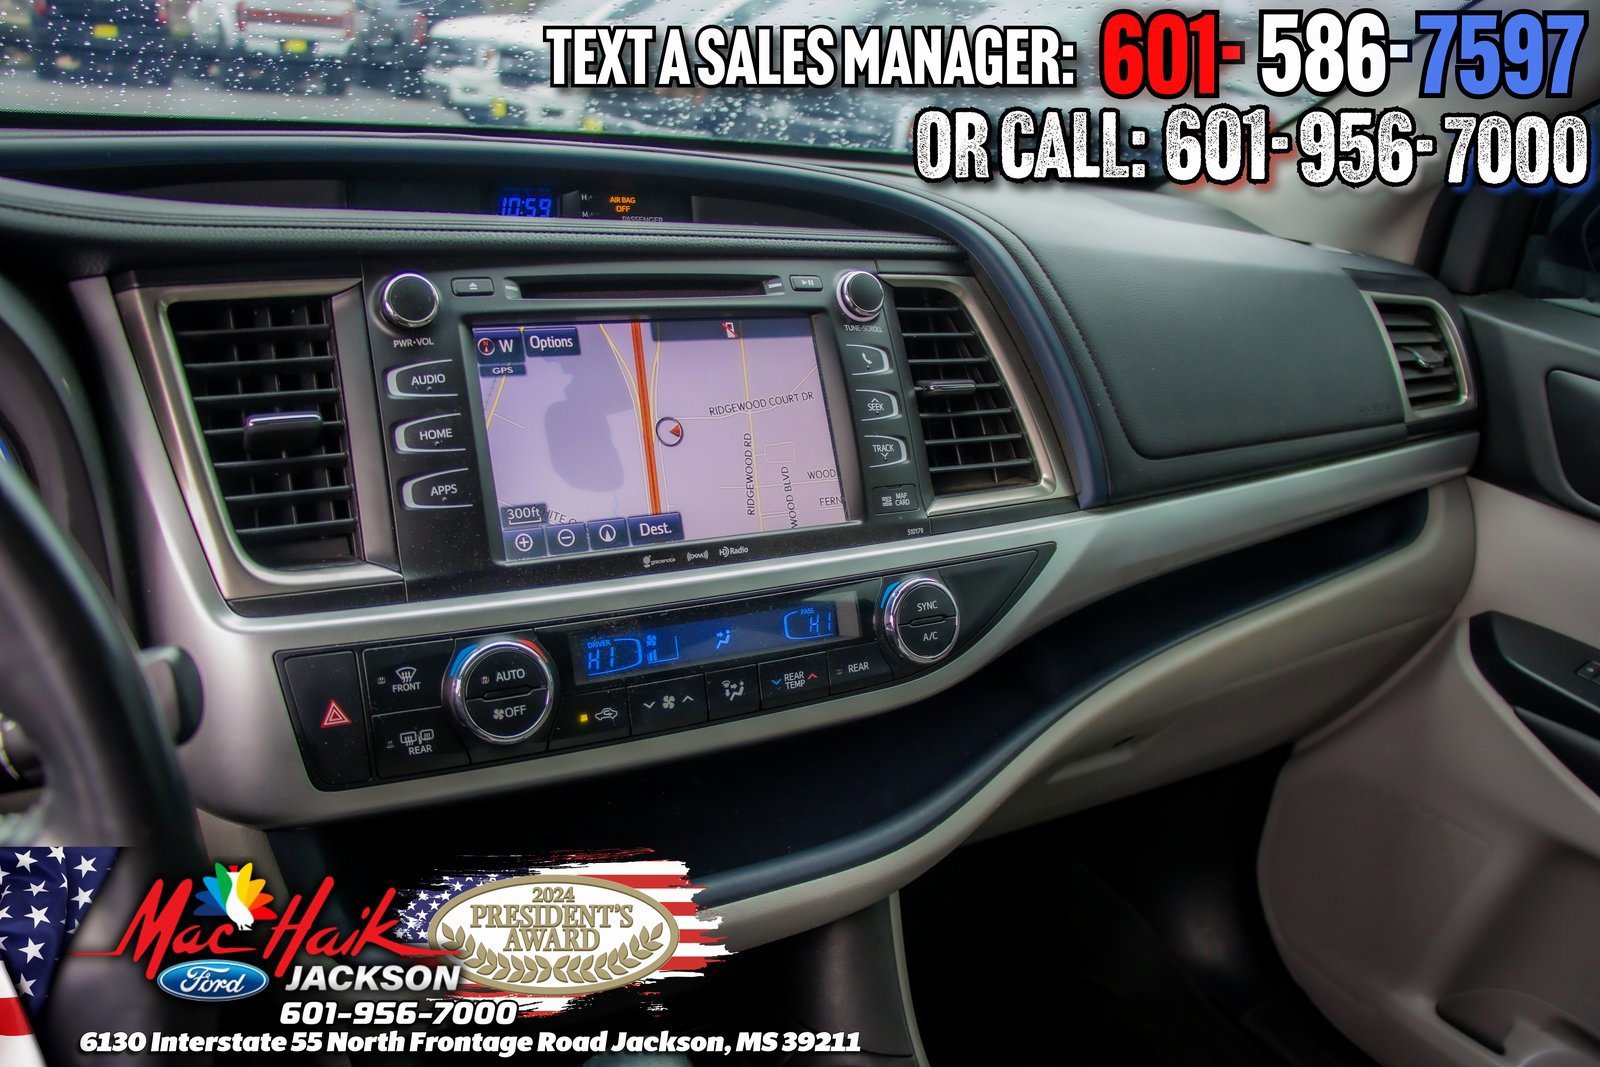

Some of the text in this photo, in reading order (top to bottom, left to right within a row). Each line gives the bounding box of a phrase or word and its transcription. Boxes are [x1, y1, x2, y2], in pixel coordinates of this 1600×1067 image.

[622, 196, 636, 204] BAG
[501, 197, 552, 217] 10:59
[616, 205, 631, 213] OFF
[499, 339, 514, 353] W
[530, 335, 574, 349] Options
[492, 366, 513, 375] GPS
[411, 373, 446, 386] AUDIO
[709, 391, 815, 416] RIDGEWOOD COURT DR
[867, 403, 885, 411] SEEK
[419, 428, 453, 441] HOME
[872, 444, 895, 452] TRACK
[744, 432, 756, 516] RIDGEWOOD RD
[780, 466, 793, 492] BLVD
[807, 469, 836, 480] WOOD
[430, 484, 458, 497] APPS
[507, 507, 541, 520] 300ft
[639, 522, 673, 537] Dest.
[730, 545, 749, 555] Radio
[800, 607, 814, 615] PASS
[917, 600, 938, 612] SYNC
[922, 631, 938, 642] A/C
[587, 639, 611, 648] DRIVER
[848, 661, 870, 674] REAR
[495, 668, 525, 682] AUTO
[784, 670, 805, 682] REAR
[392, 682, 421, 693] FRONT
[785, 678, 806, 690] TEMP
[505, 704, 527, 718] OFF
[408, 744, 433, 755] REAR
